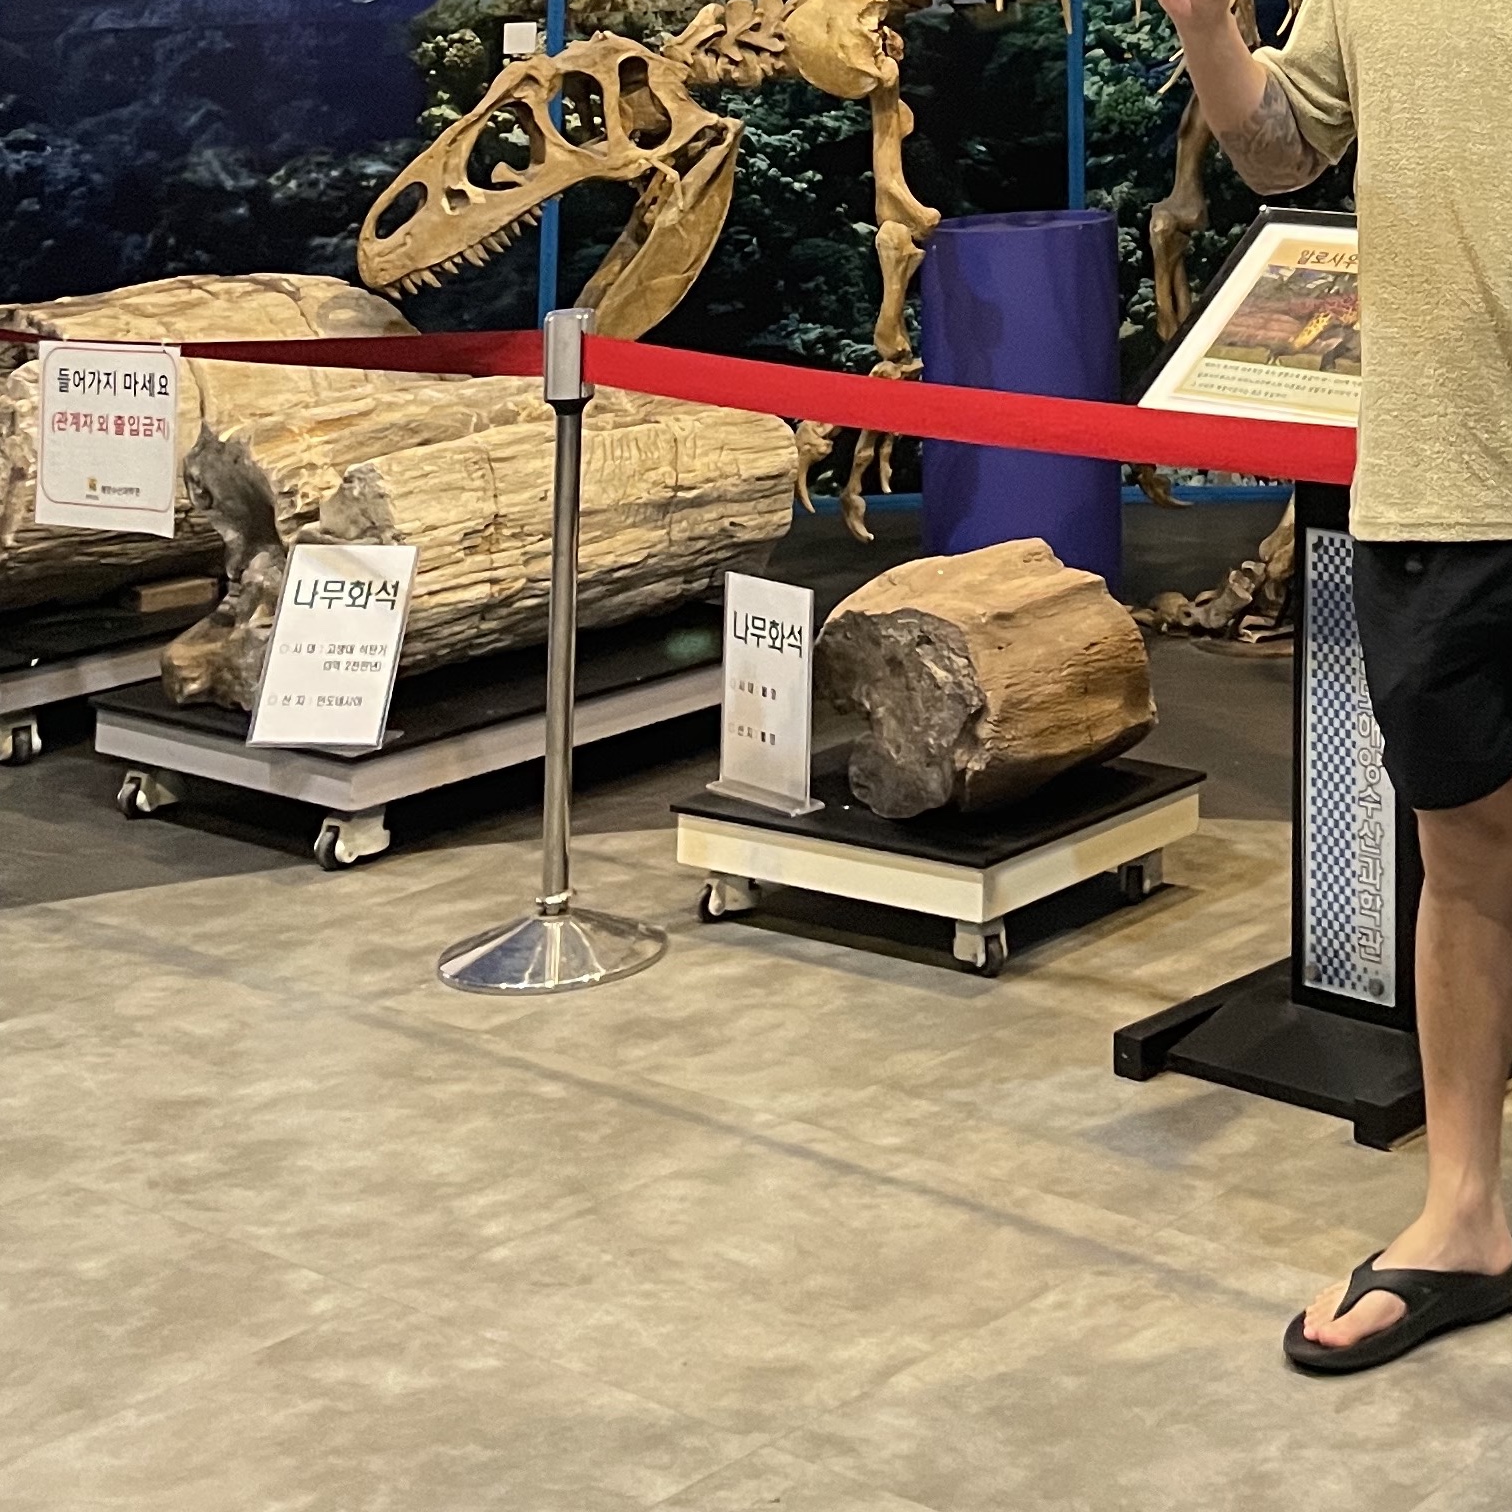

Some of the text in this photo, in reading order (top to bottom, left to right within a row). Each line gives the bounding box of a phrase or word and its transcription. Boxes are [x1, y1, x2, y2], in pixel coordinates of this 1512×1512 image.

[1297, 249, 1358, 269] 알로사우
[57, 367, 170, 397] 들어가지 마세요
[97, 413, 109, 434] 외
[293, 578, 400, 611] 나무화석
[733, 610, 803, 658] 나무화석
